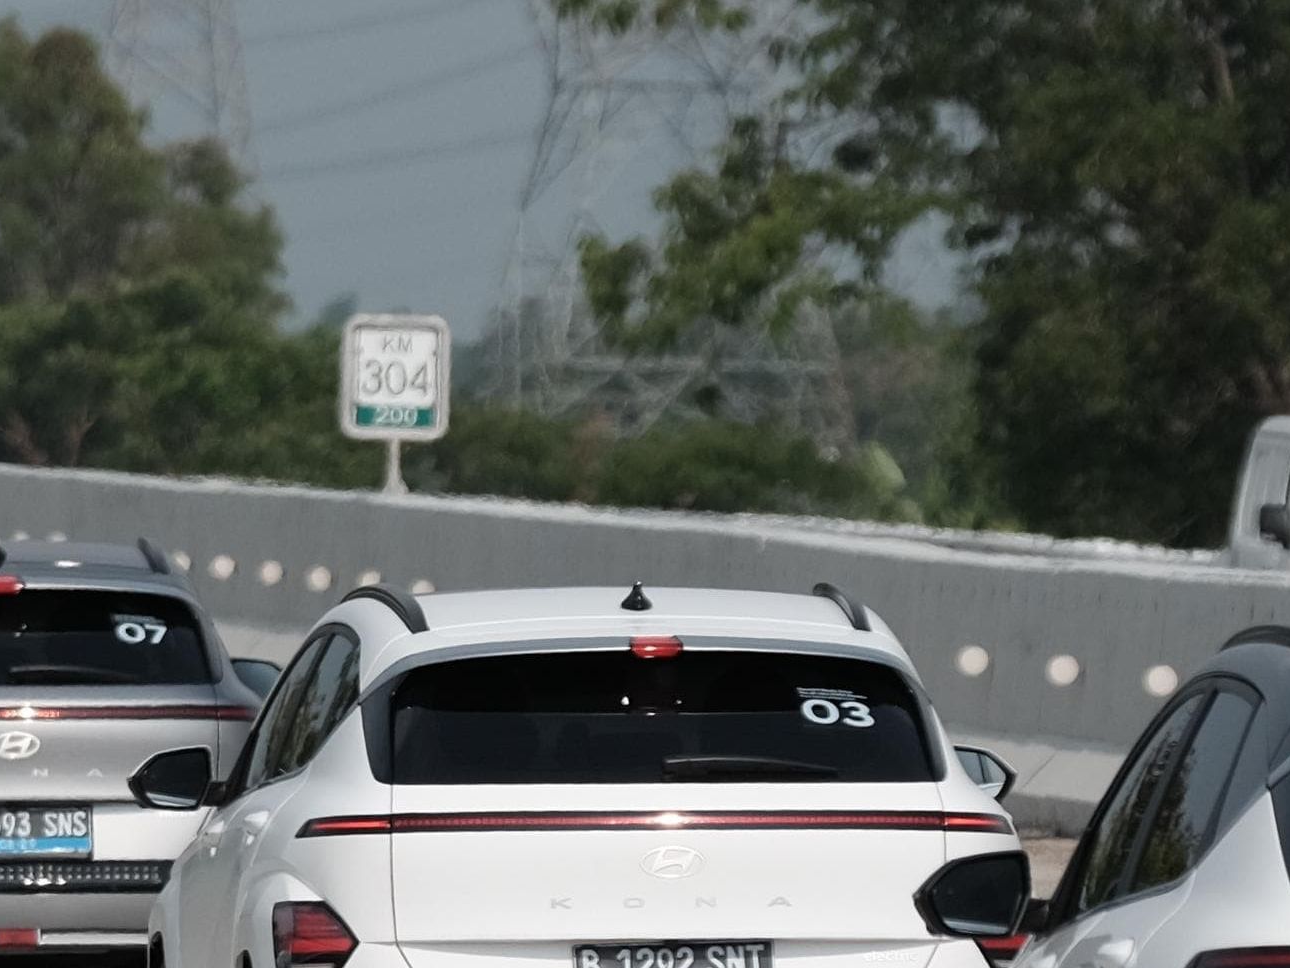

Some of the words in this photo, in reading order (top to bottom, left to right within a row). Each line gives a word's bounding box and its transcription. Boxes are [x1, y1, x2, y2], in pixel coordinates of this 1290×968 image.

[383, 335, 414, 352] KM
[362, 359, 429, 396] 304
[375, 408, 418, 426] 200
[115, 622, 167, 644] 07
[801, 699, 875, 727] 03
[43, 811, 87, 837] SNS
